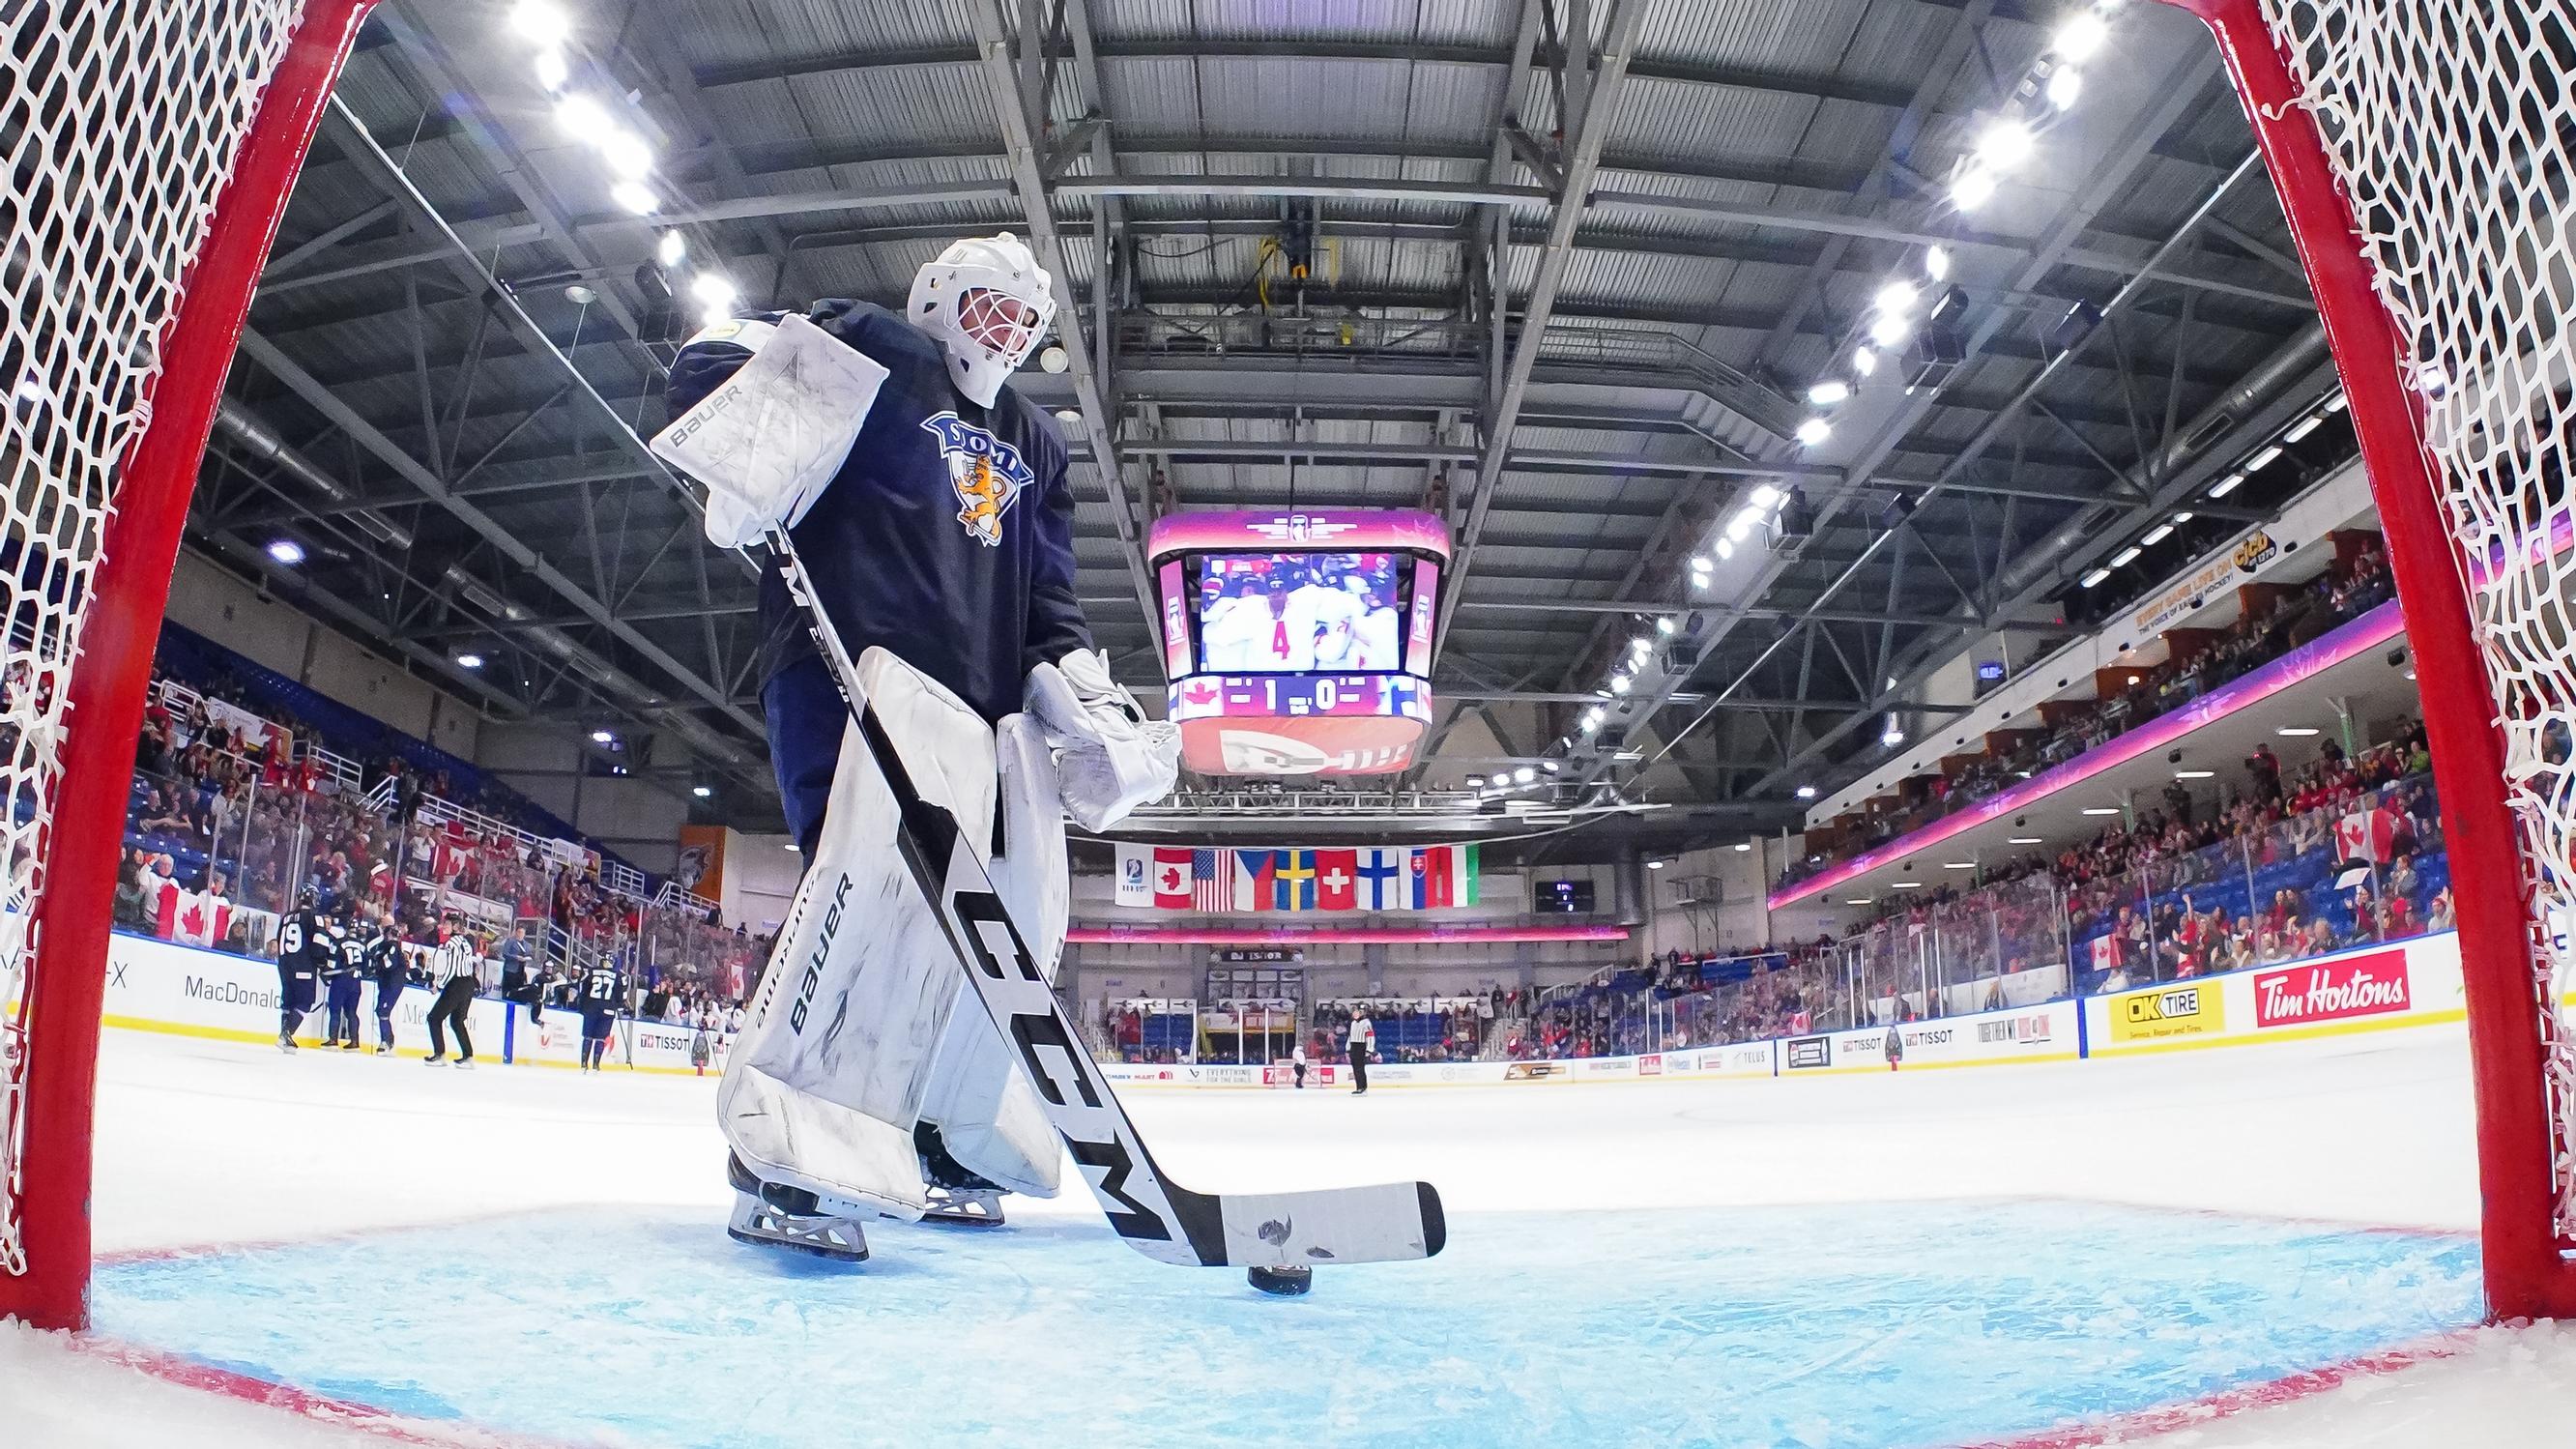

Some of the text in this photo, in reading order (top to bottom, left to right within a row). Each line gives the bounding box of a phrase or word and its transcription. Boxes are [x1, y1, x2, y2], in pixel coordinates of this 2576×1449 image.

[279, 923, 303, 956] 19
[590, 975, 615, 1000] 27
[2260, 969, 2404, 1021] Tim Hortons
[2127, 993, 2196, 1023] OK TIRE
[655, 1035, 689, 1051] TISSOT
[1854, 1037, 1881, 1051] TISSOT
[1919, 1029, 1954, 1045] TISSOT
[952, 890, 1172, 1241] CCM
